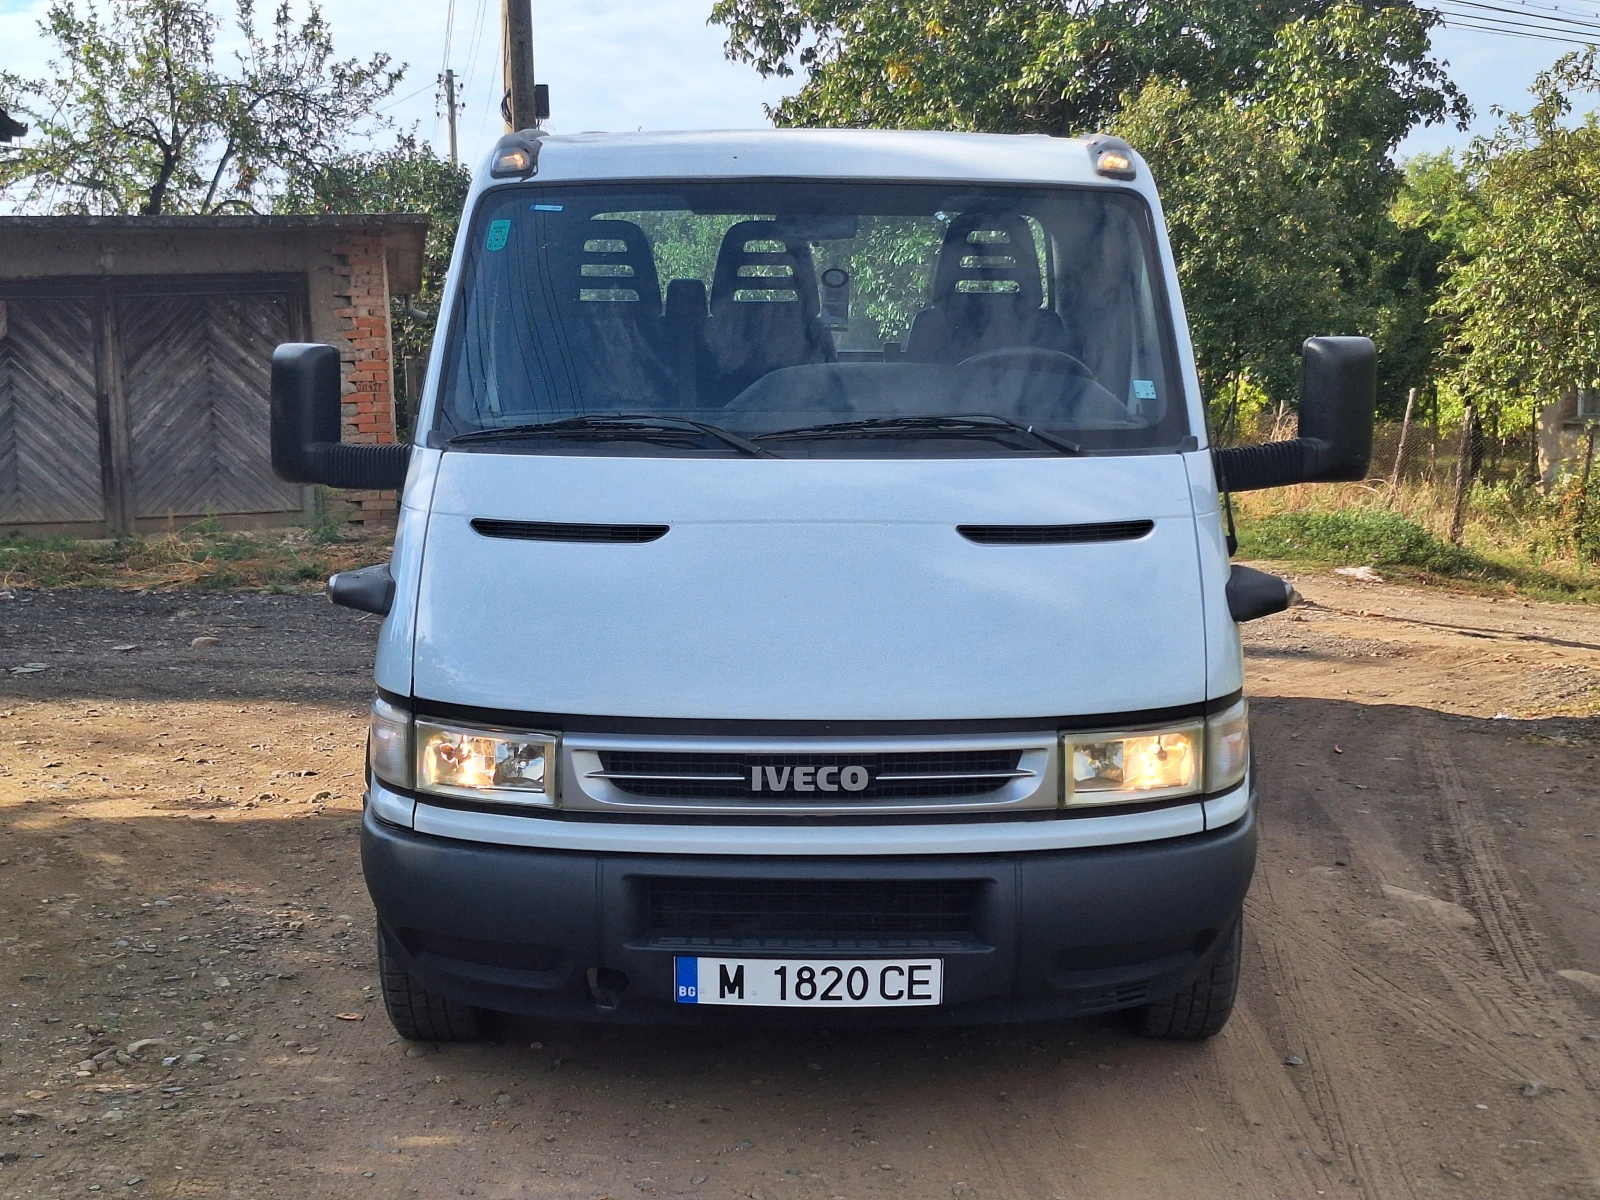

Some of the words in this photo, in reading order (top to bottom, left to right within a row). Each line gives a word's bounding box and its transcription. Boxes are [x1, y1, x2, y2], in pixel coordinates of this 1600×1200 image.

[751, 765, 869, 792] IVECO
[678, 986, 696, 997] BG
[719, 964, 744, 999] M
[774, 965, 869, 1001] 1820
[879, 964, 932, 1000] CE
